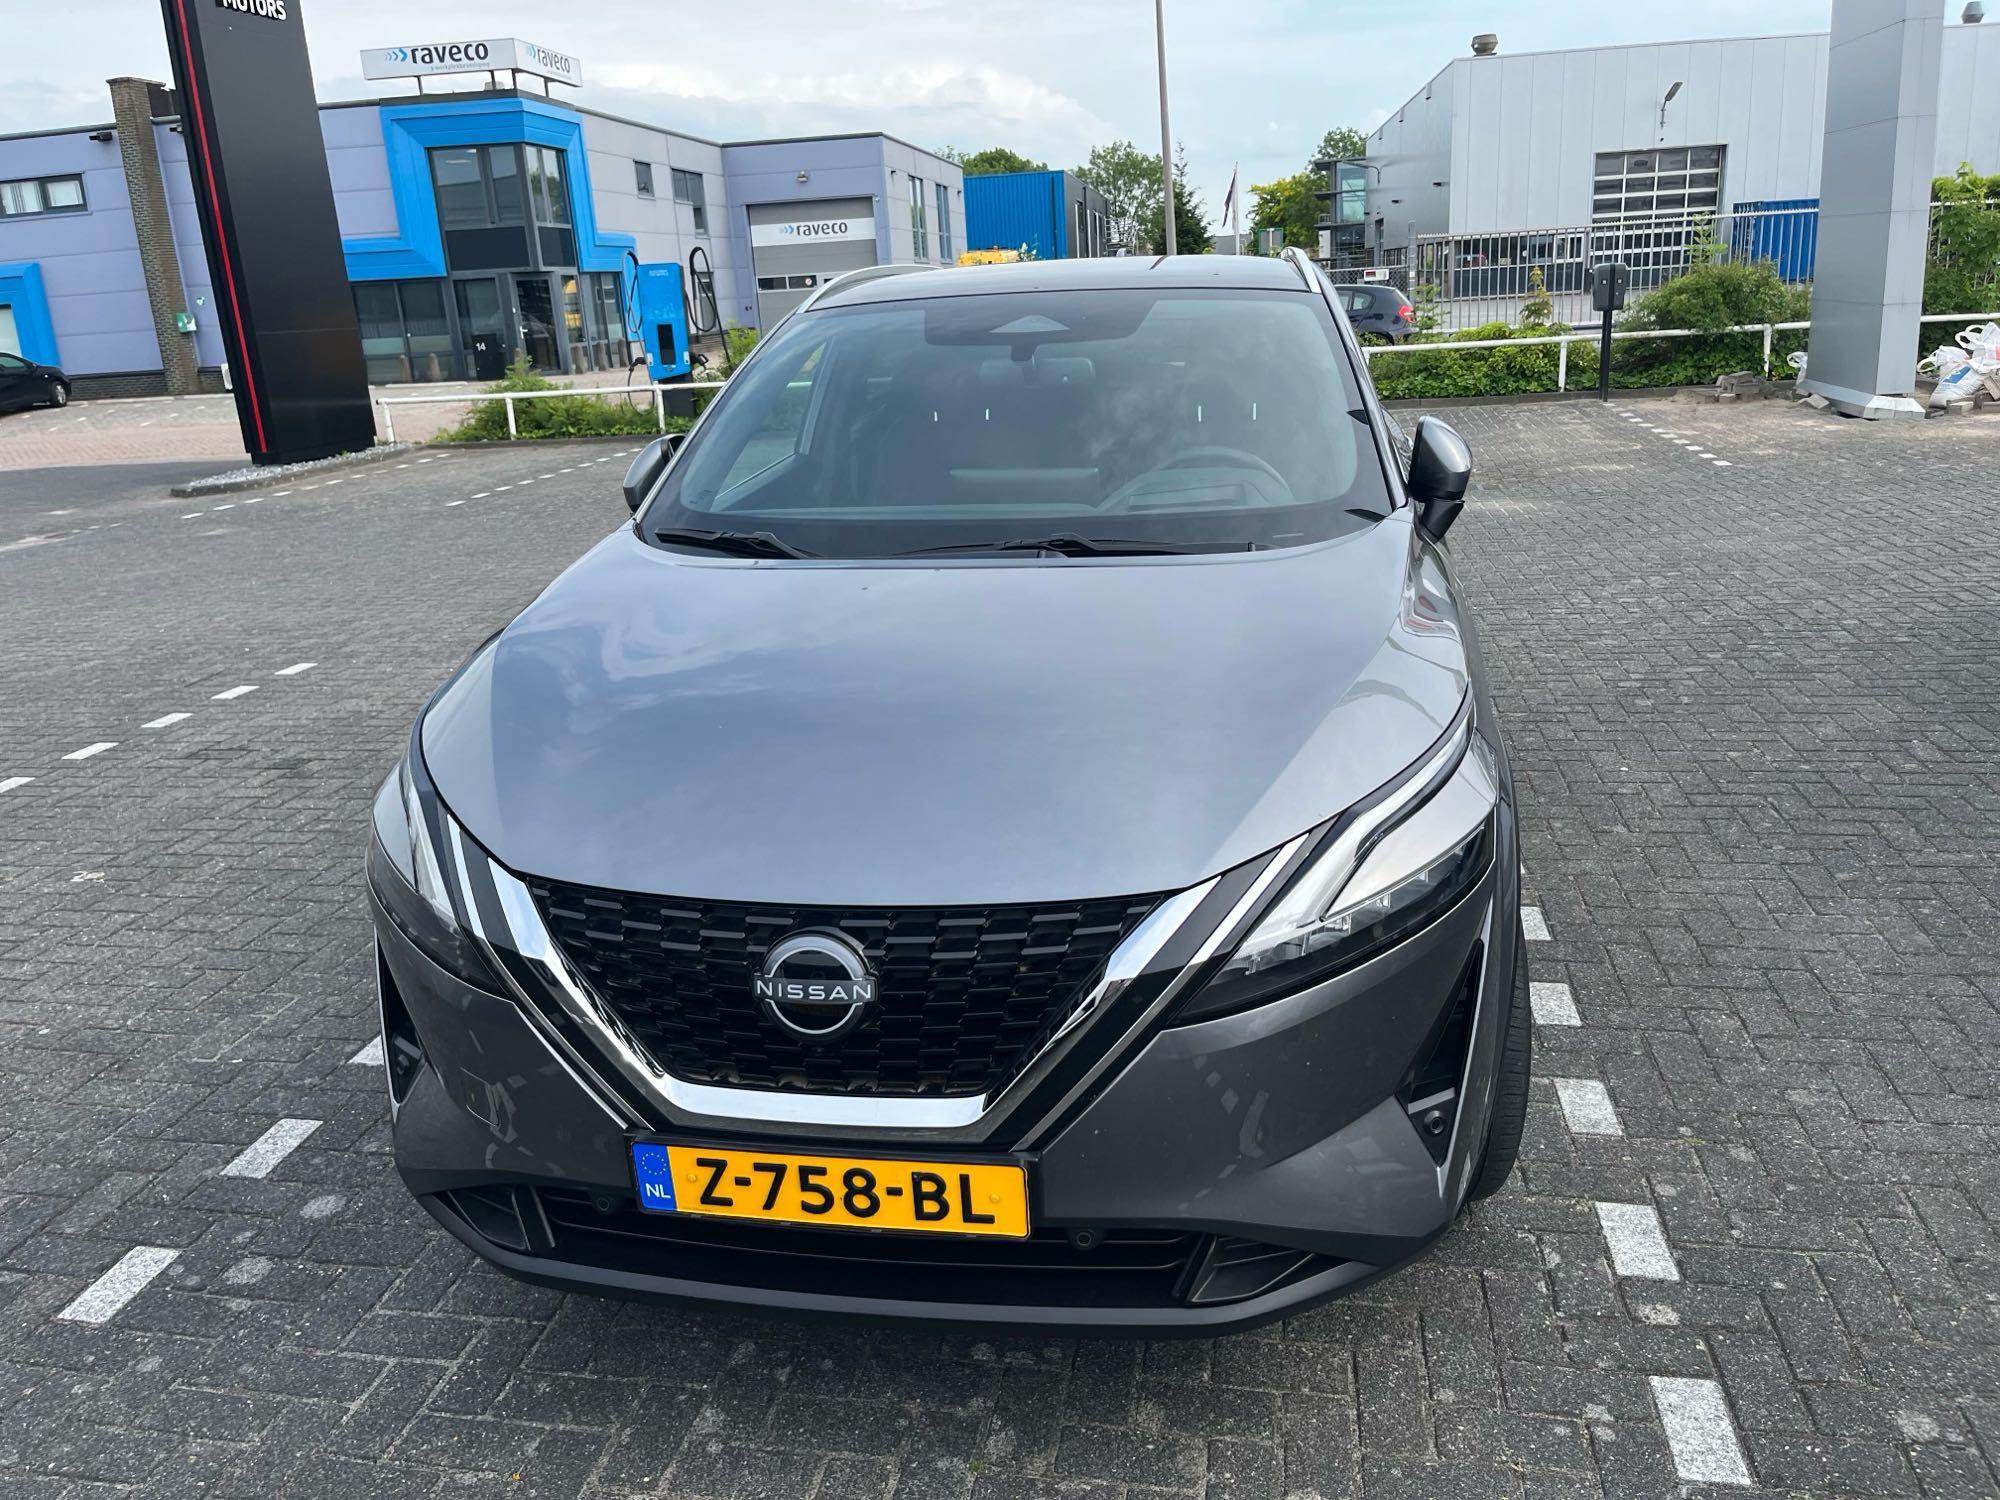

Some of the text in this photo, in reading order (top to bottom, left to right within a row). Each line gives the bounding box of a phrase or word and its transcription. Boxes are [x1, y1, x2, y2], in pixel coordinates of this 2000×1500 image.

[410, 42, 489, 65] raveco
[537, 48, 570, 74] raveco
[796, 221, 848, 236] raveco
[476, 342, 487, 352] 14
[756, 980, 871, 1000] NISSAN
[645, 1183, 671, 1199] NL
[696, 1157, 996, 1225] Z-758-BL
